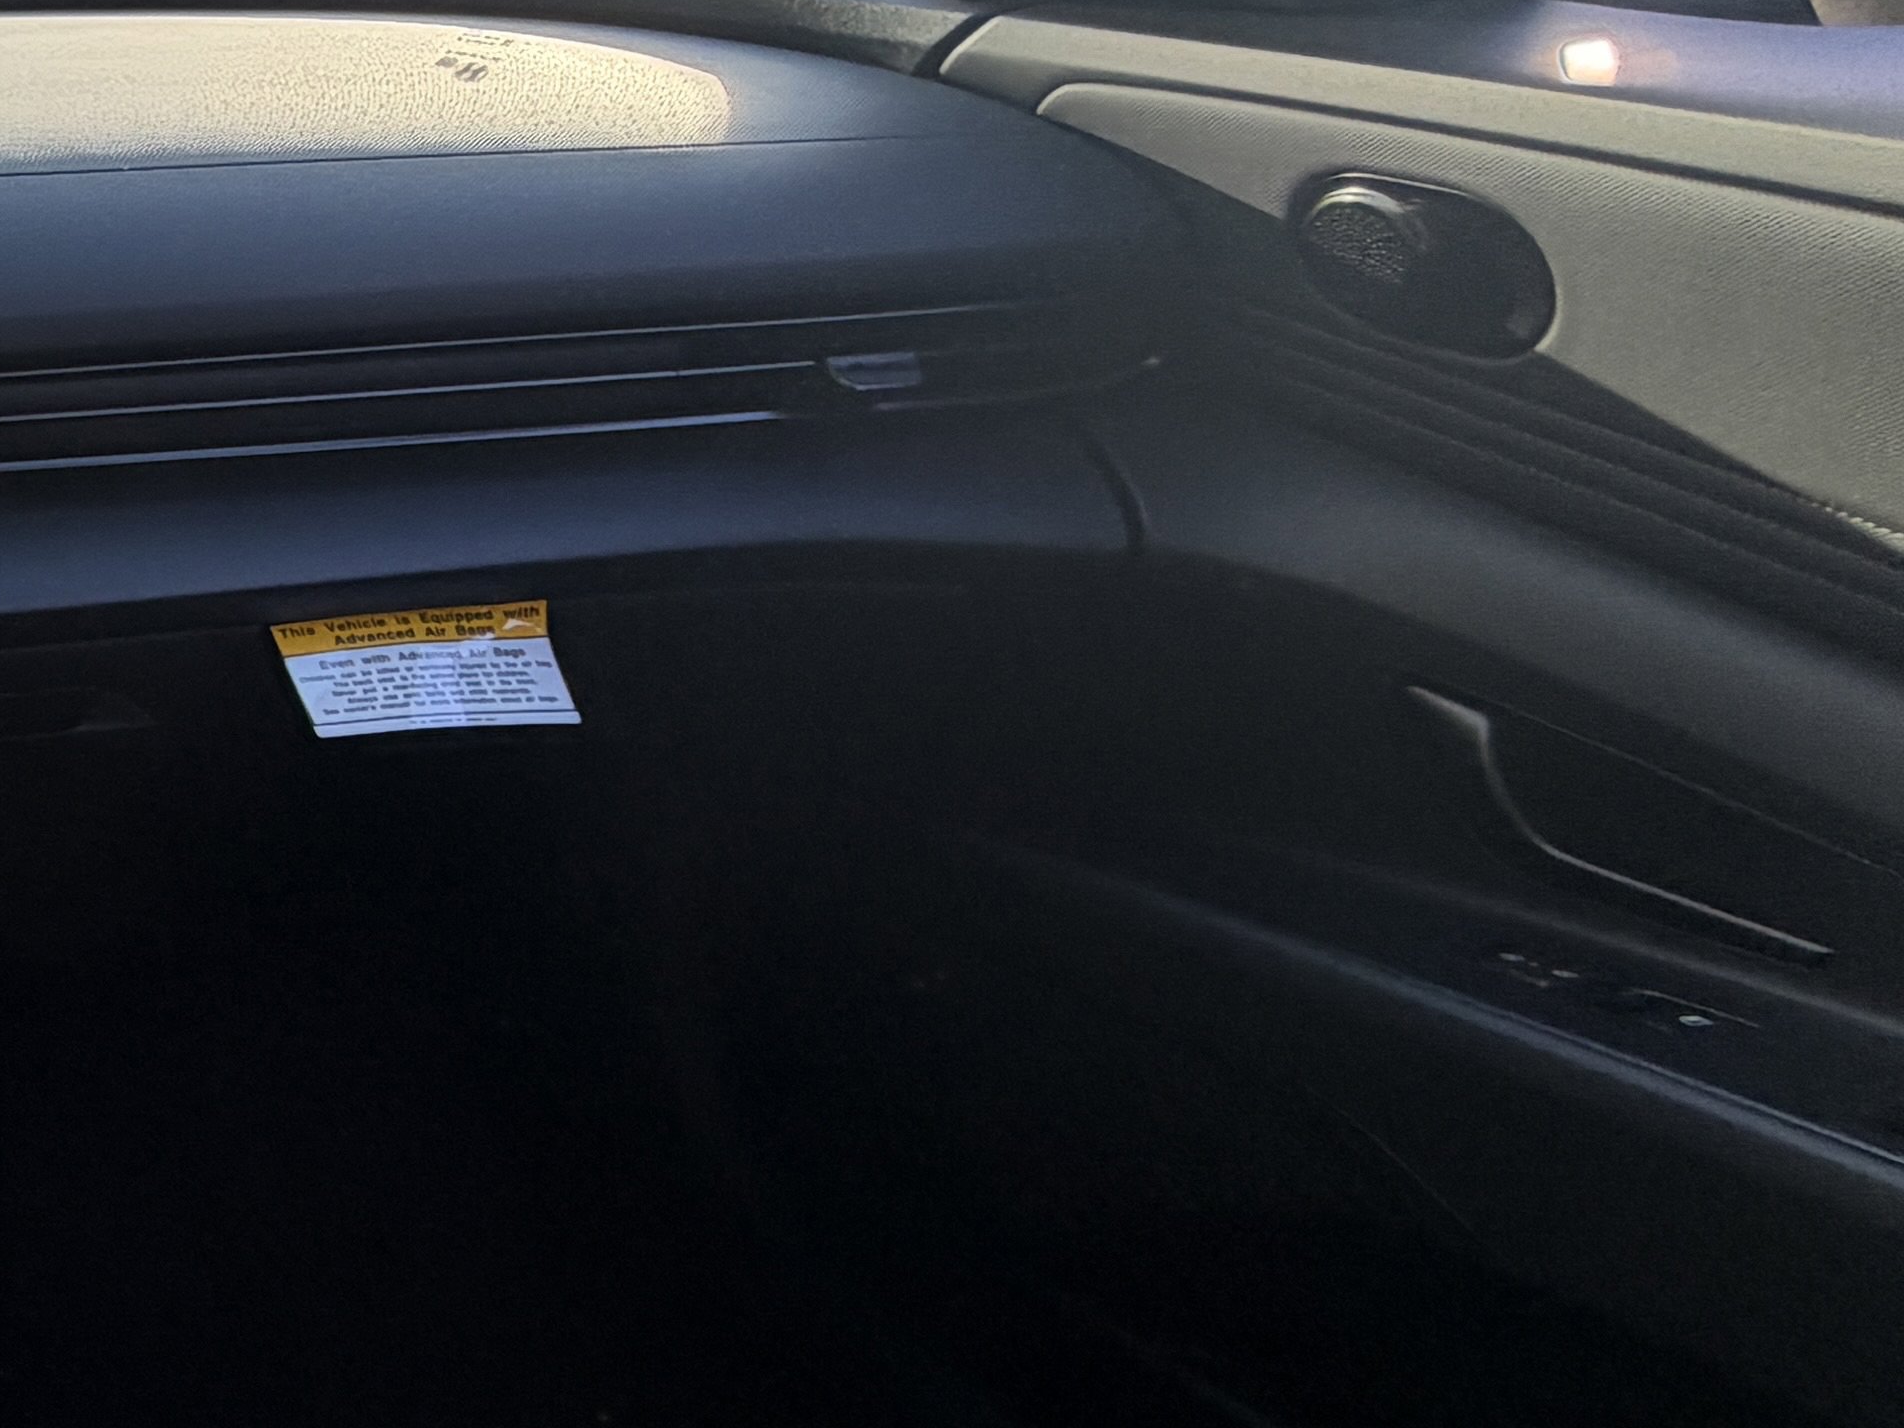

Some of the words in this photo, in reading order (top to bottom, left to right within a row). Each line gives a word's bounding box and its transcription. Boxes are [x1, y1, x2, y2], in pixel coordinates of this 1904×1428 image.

[278, 625, 316, 639] This
[323, 616, 388, 633] Vehicle
[418, 609, 495, 625] Equipped
[502, 605, 540, 619] with
[334, 627, 416, 646] Advanced
[424, 625, 447, 637] Air
[454, 623, 496, 638] Bags
[319, 659, 355, 670] Even
[360, 654, 392, 664] with
[398, 650, 463, 661] Advanced
[469, 649, 486, 658] Air
[493, 646, 527, 659] Bags
